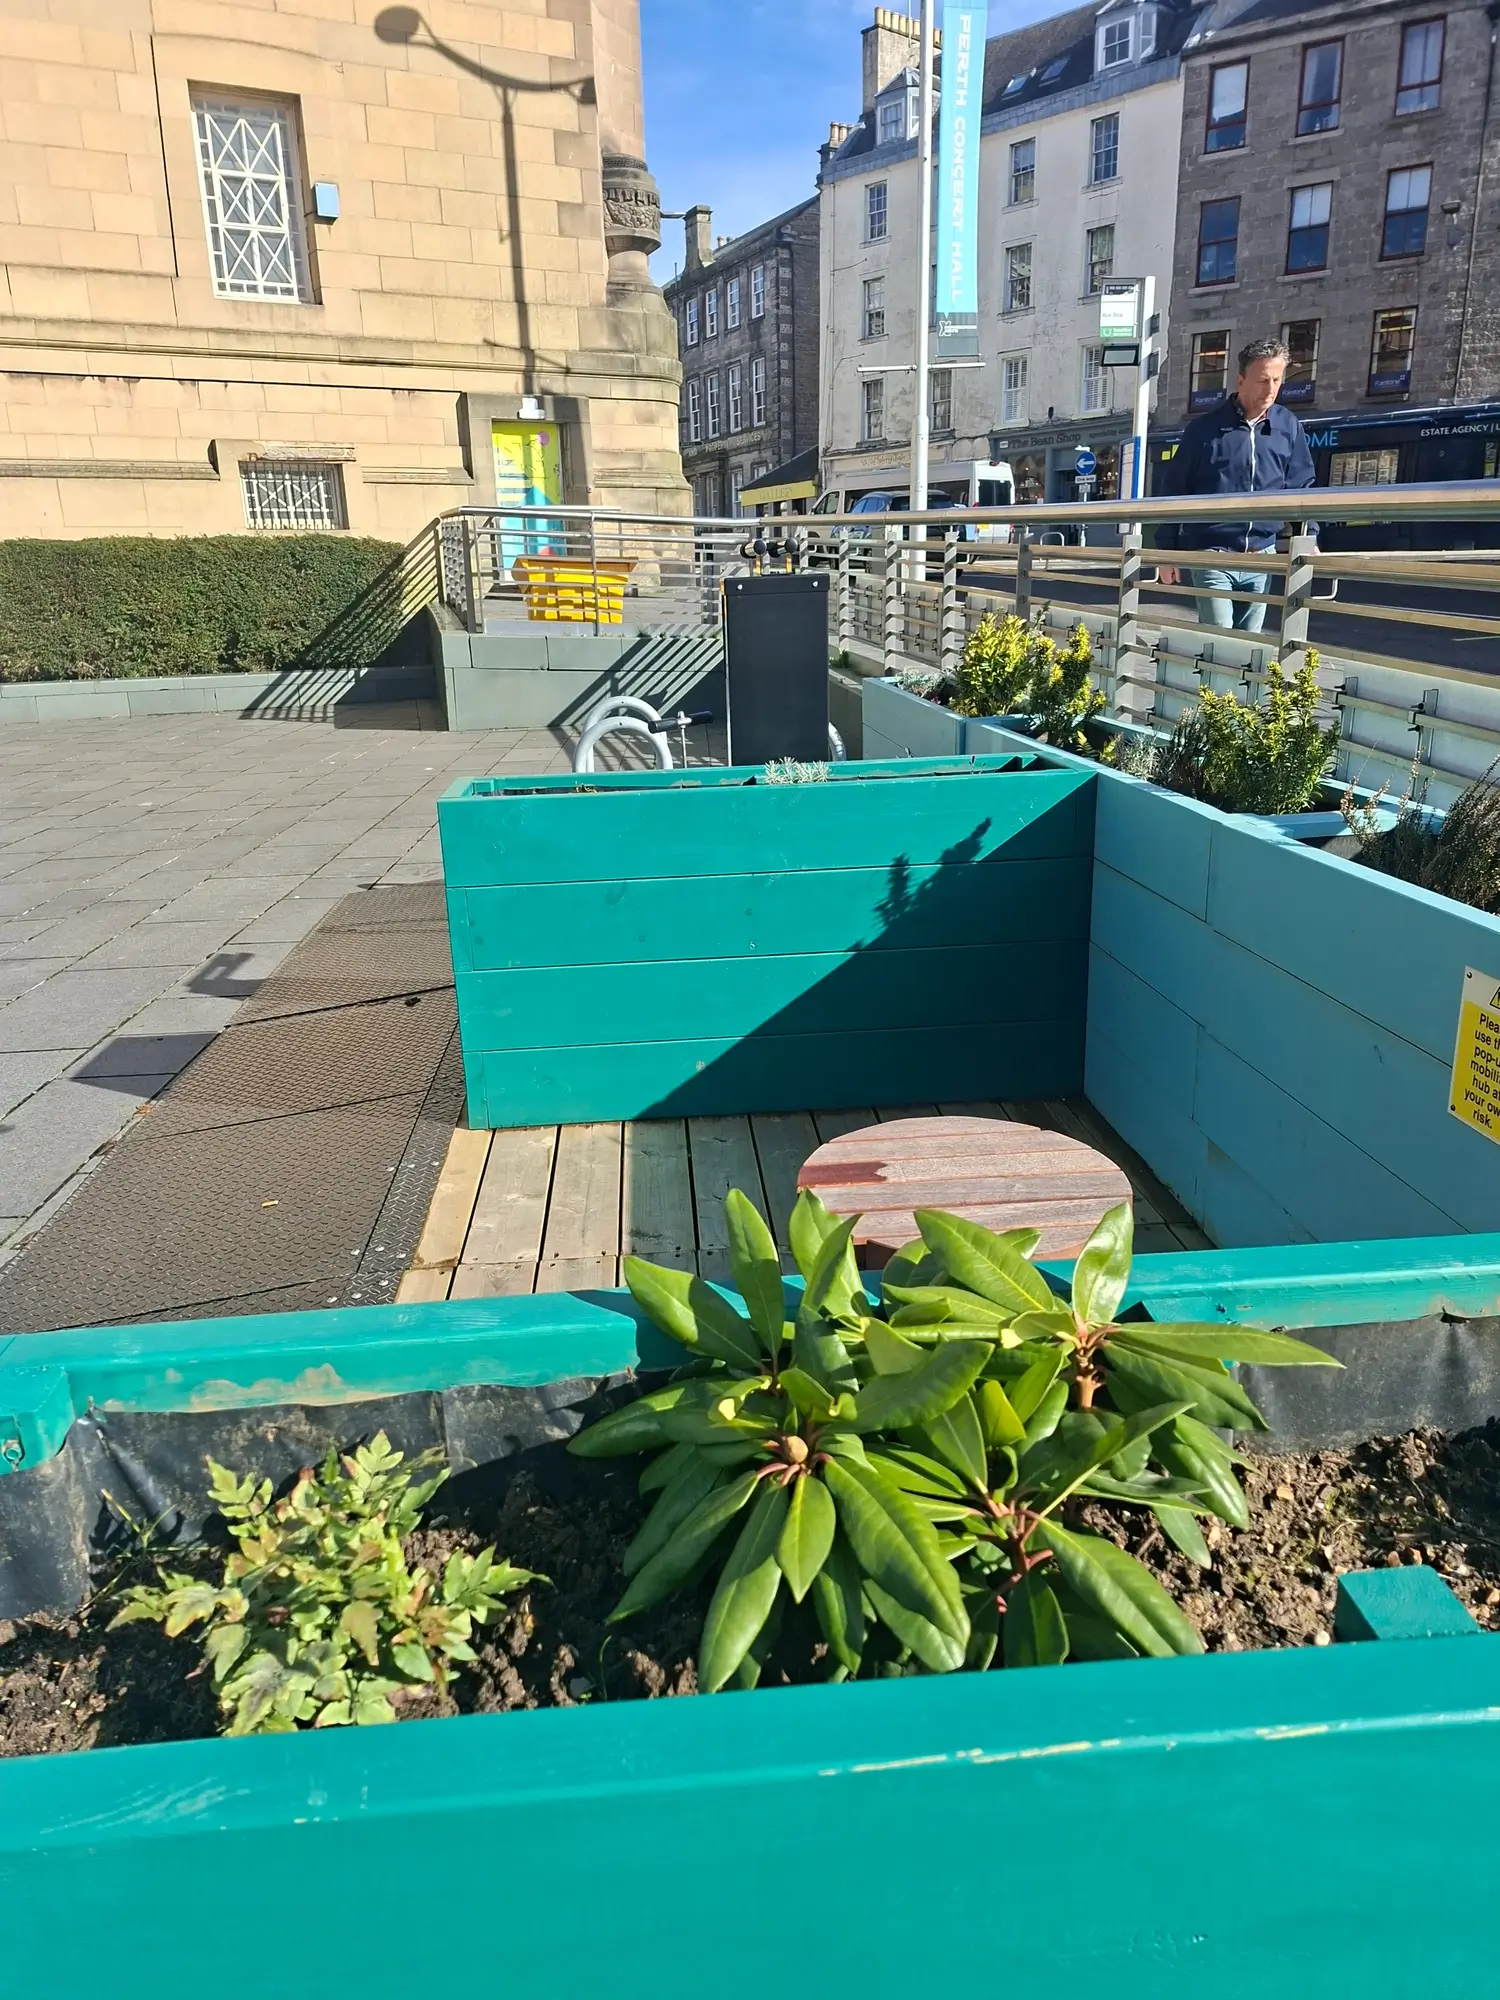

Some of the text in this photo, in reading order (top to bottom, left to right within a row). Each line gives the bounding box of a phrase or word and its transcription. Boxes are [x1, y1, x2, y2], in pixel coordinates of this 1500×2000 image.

[955, 14, 972, 107] PERTH
[951, 115, 967, 231] CONCERT
[950, 241, 964, 303] HALL
[735, 430, 761, 447] SERVICES
[1030, 435, 1054, 447] Bean
[1055, 431, 1081, 445] Shop
[1421, 426, 1450, 437] ESTATE
[1451, 423, 1489, 435] AGENCY
[1474, 1029, 1492, 1046] use
[1470, 1059, 1500, 1084] mobili
[1472, 1074, 1490, 1095] hub
[1464, 1087, 1485, 1108] your
[1472, 1108, 1493, 1130] risk.
